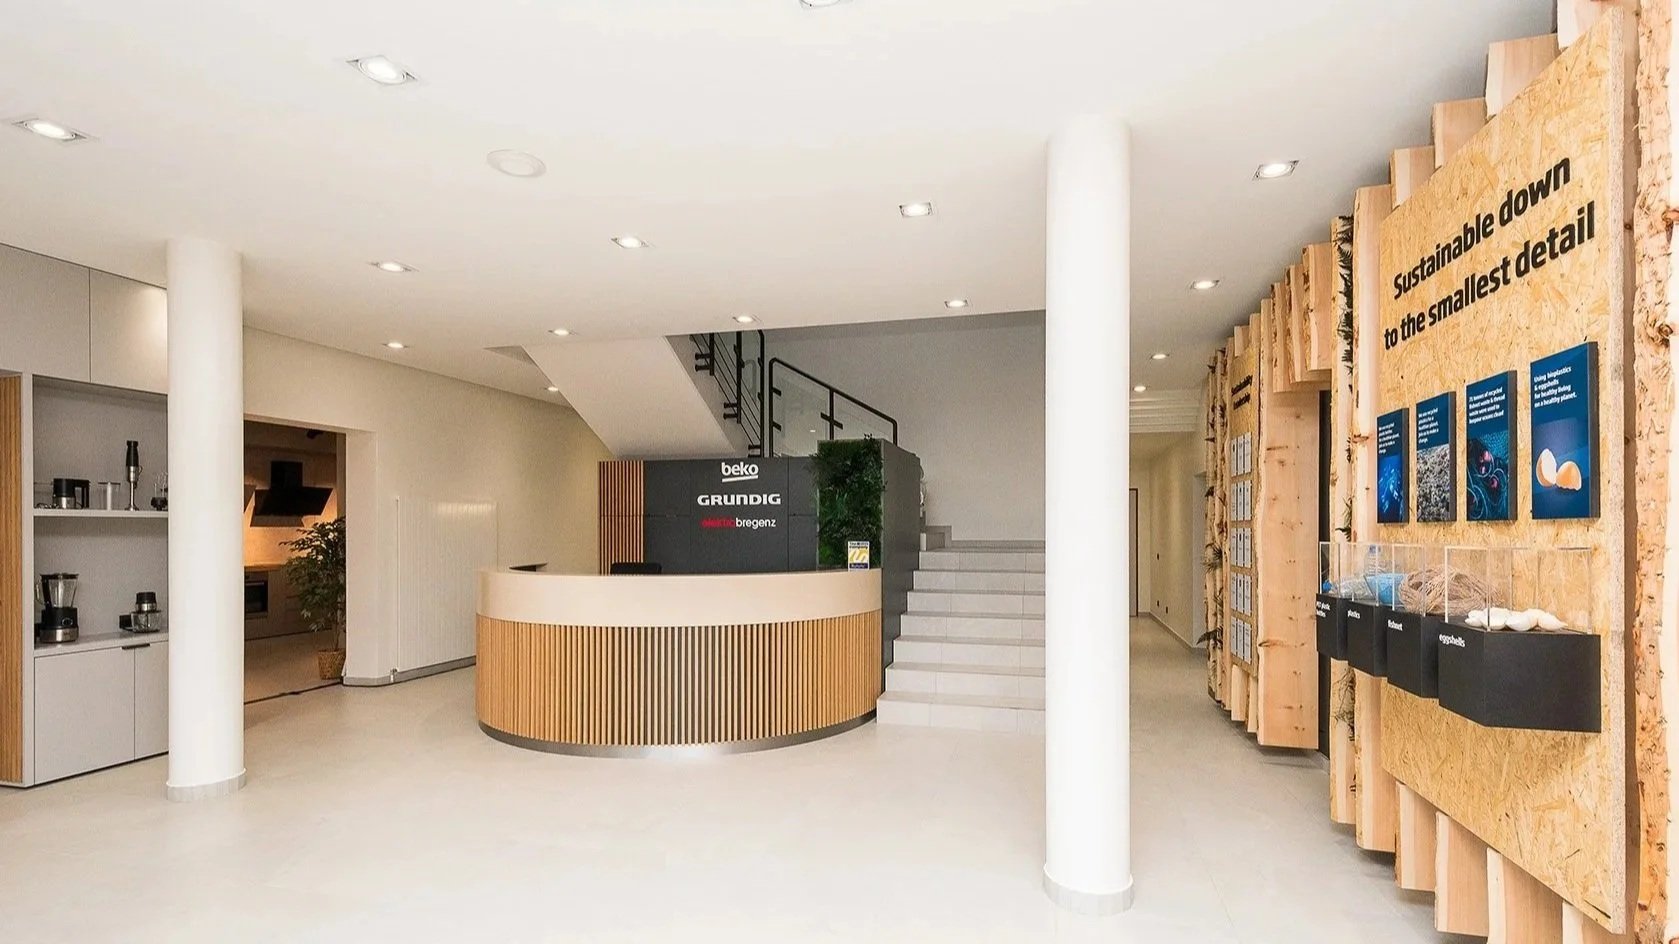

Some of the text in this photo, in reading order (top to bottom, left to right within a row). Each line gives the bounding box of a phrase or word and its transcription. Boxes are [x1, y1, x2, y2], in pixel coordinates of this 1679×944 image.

[1394, 157, 1570, 300] Sustainable down
[1384, 200, 1595, 350] to the smallest detail
[1534, 366, 1571, 383] Using bioplastics
[1541, 388, 1557, 398] healthy
[721, 461, 759, 476] beko
[697, 493, 781, 506] GRUNDIG
[1439, 633, 1466, 648] eggshells
